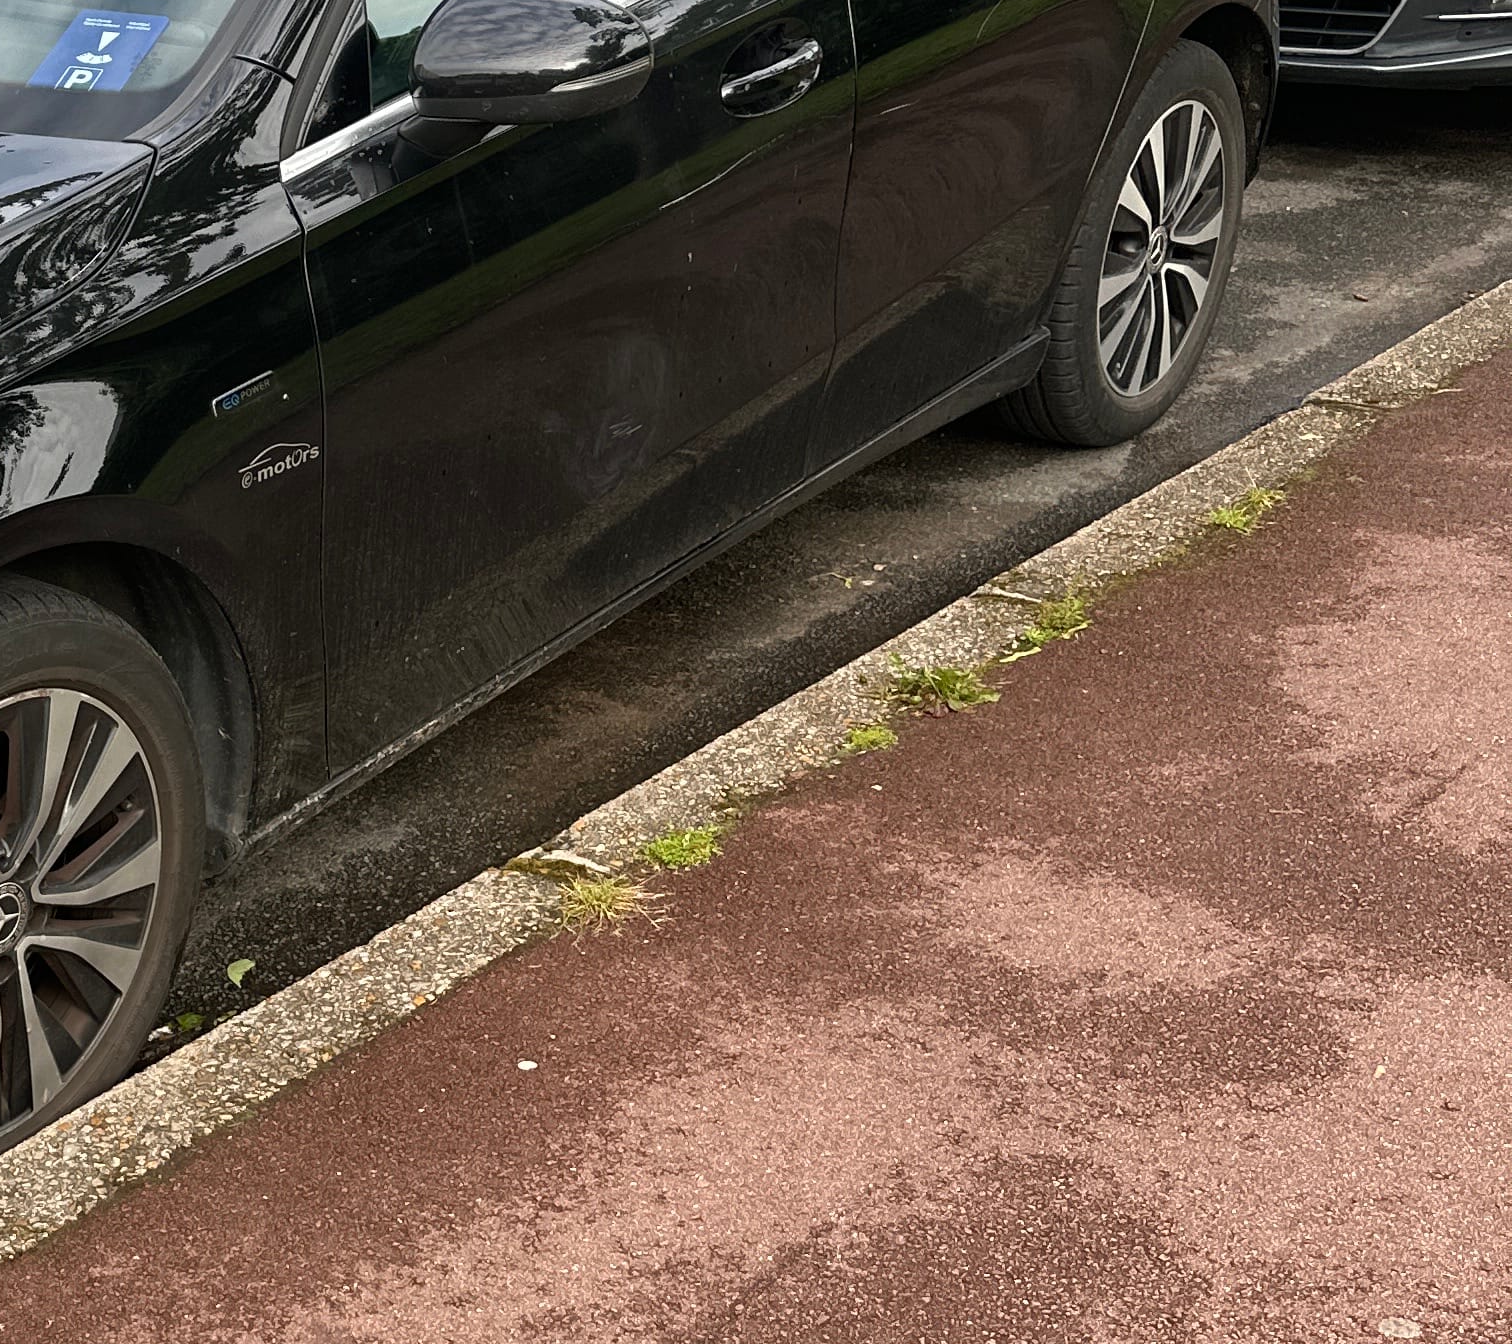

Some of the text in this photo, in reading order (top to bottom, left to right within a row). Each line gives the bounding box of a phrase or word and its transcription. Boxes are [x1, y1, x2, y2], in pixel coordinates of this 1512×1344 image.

[64, 69, 93, 89] P
[222, 379, 270, 410] EQ POWER
